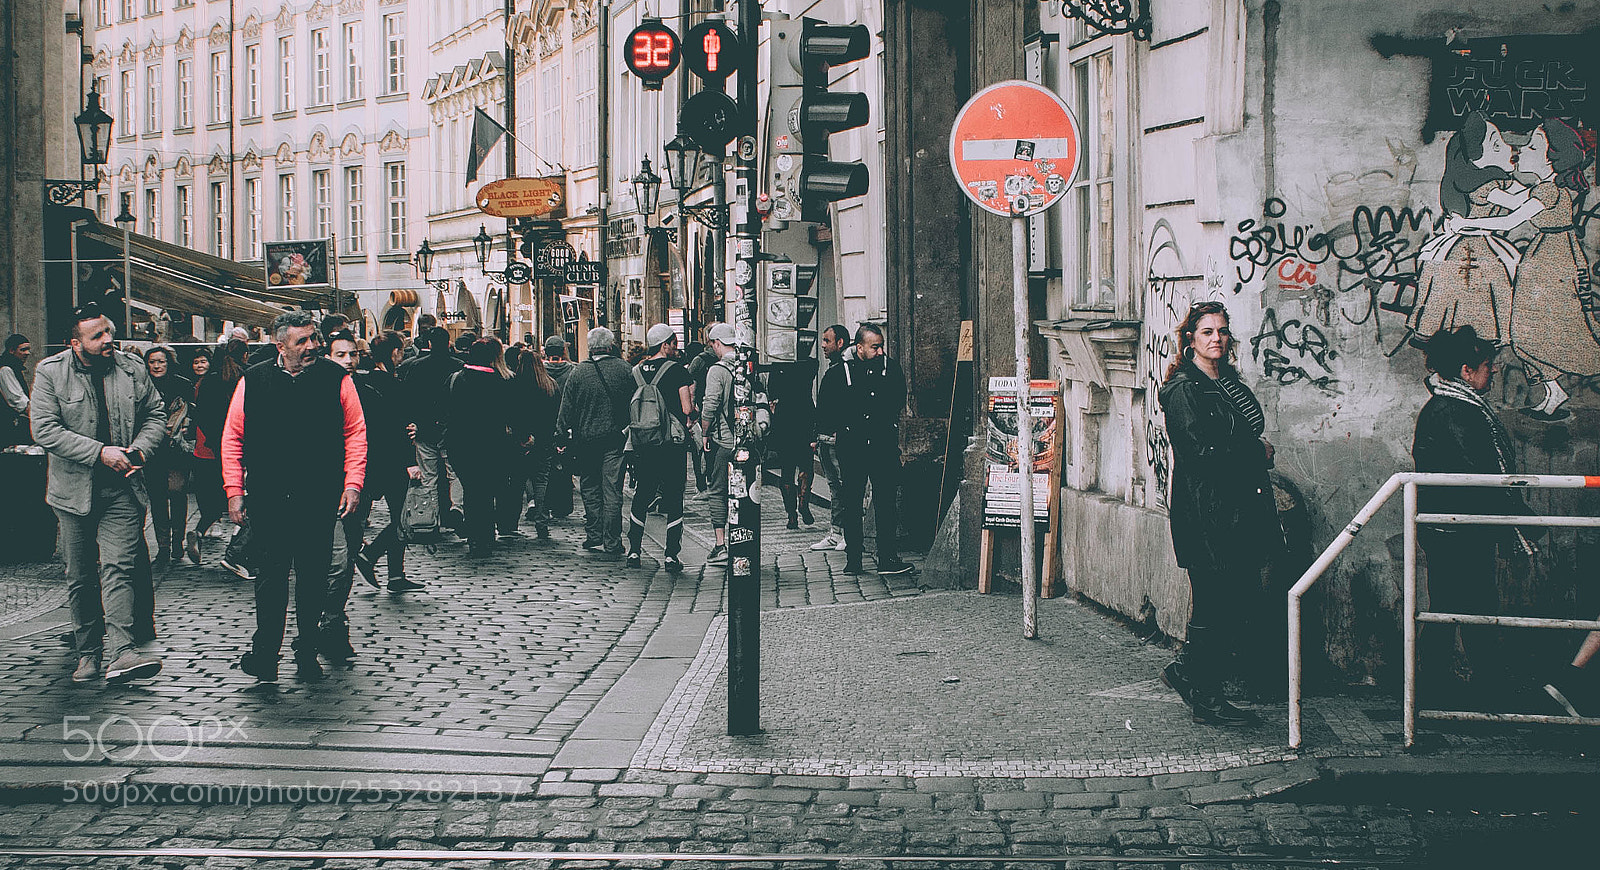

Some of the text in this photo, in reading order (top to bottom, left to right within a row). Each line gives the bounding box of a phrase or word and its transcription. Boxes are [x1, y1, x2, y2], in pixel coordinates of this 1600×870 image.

[634, 32, 673, 67] 32
[1449, 58, 1587, 90] FUCK
[487, 188, 552, 200] BLACK LIGHT
[498, 199, 543, 209] THEATRE
[550, 248, 570, 258] GOOD
[566, 264, 599, 272] MUSIC
[566, 272, 600, 282] CLUB
[994, 379, 1017, 388] TODAY
